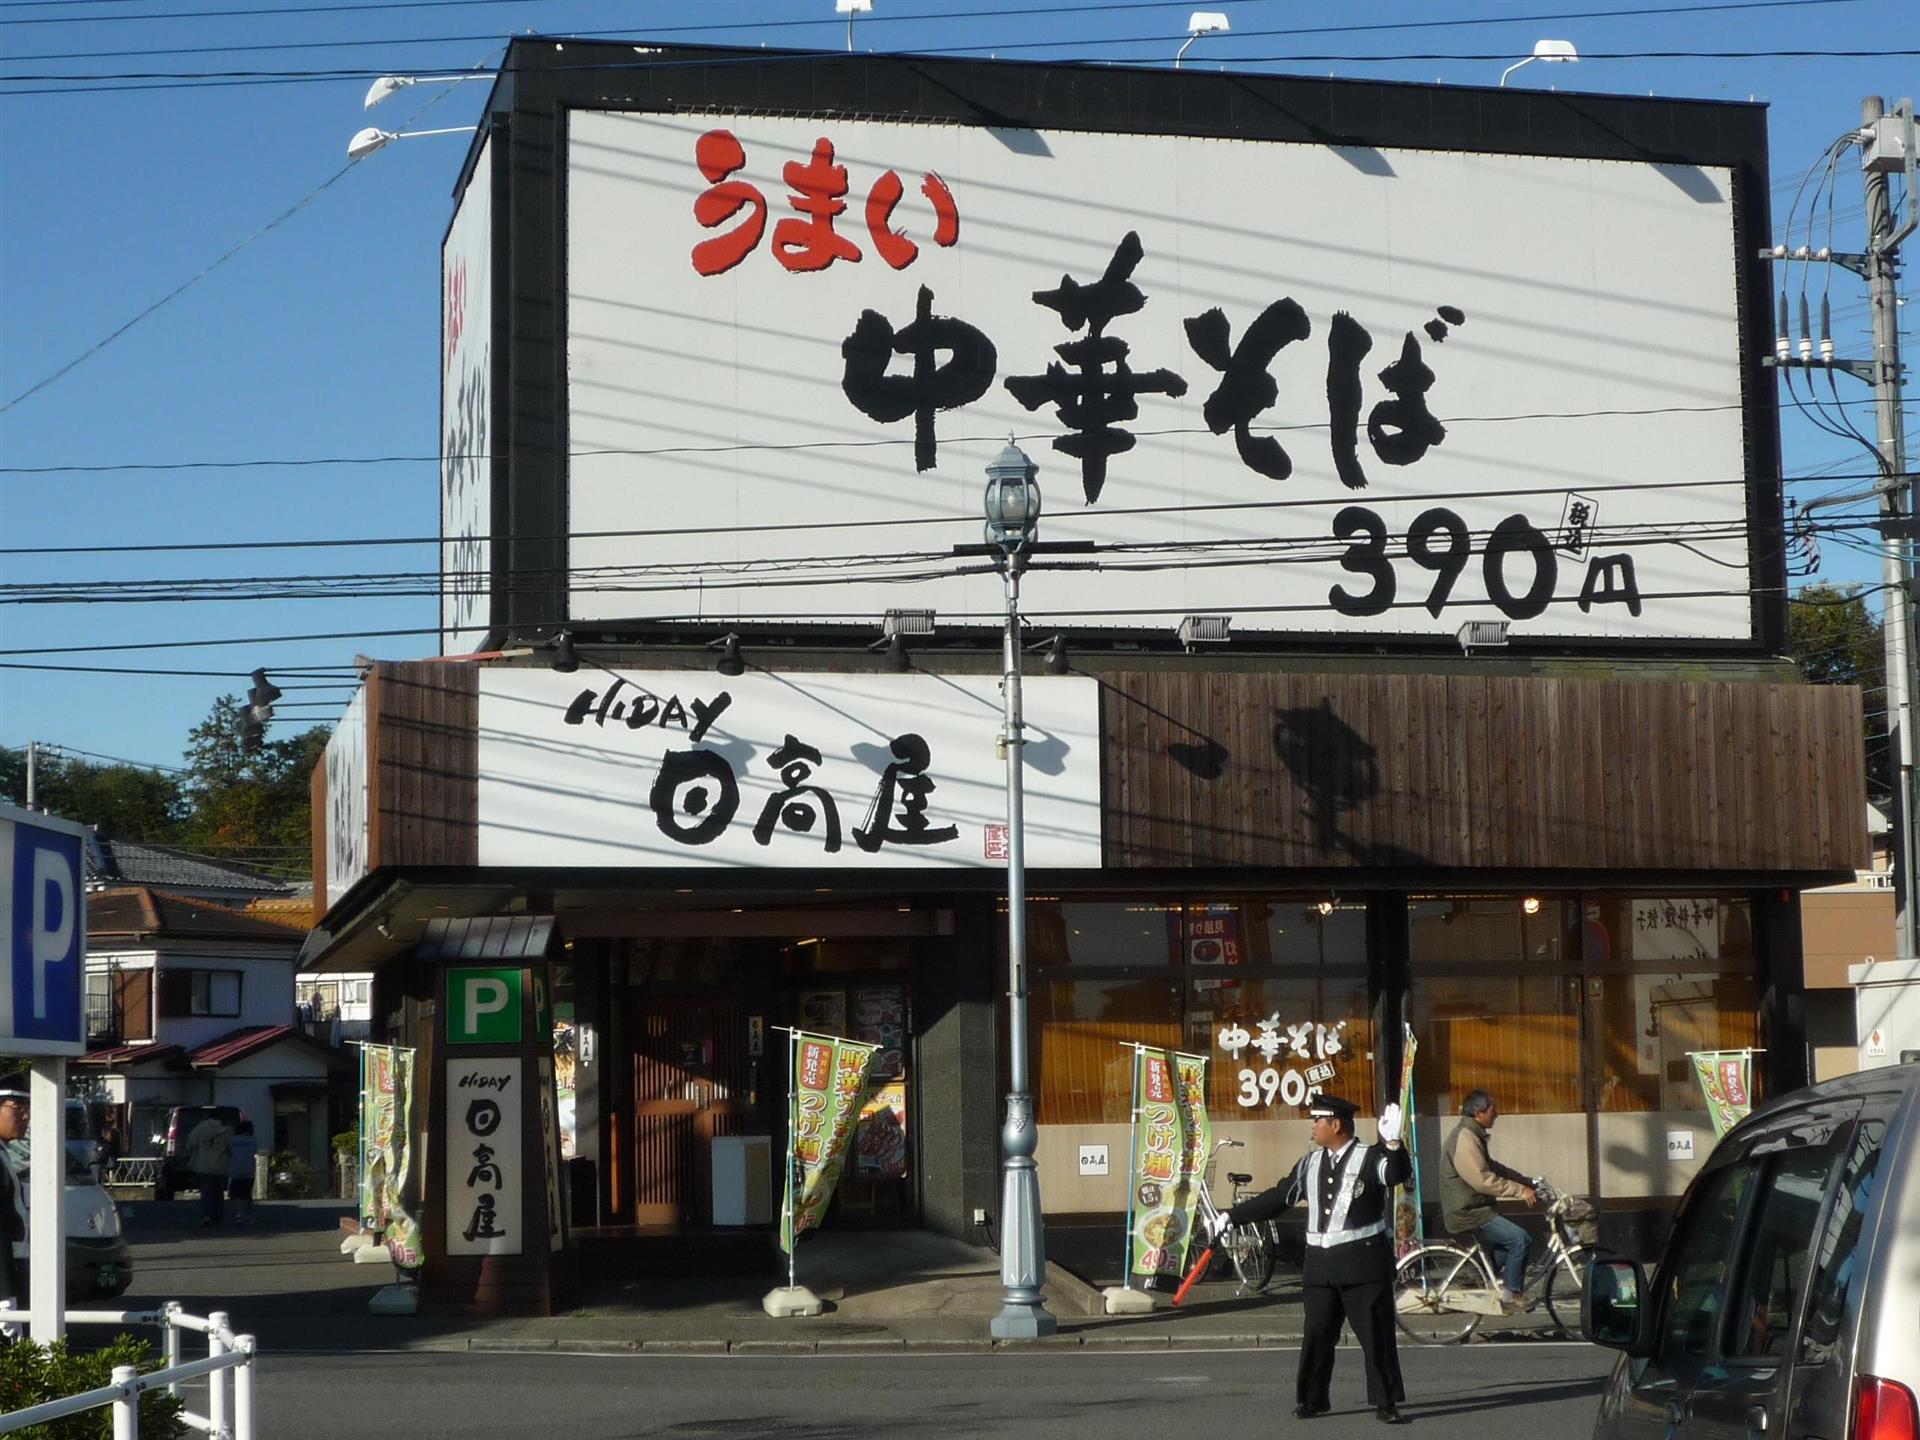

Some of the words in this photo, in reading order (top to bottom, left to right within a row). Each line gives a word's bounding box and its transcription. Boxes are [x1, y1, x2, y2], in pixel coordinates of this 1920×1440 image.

[692, 129, 960, 275] うまい
[841, 231, 1466, 505] 中華そば
[1329, 506, 1642, 620] 390円
[649, 733, 959, 853] 日高屋
[33, 848, 75, 1019] P
[464, 978, 509, 1035] P
[1218, 1011, 1347, 1064] 中華そば
[463, 1098, 505, 1242] 日高屋
[795, 1091, 827, 1164] つけ麺
[1142, 1105, 1176, 1181] つけ麺
